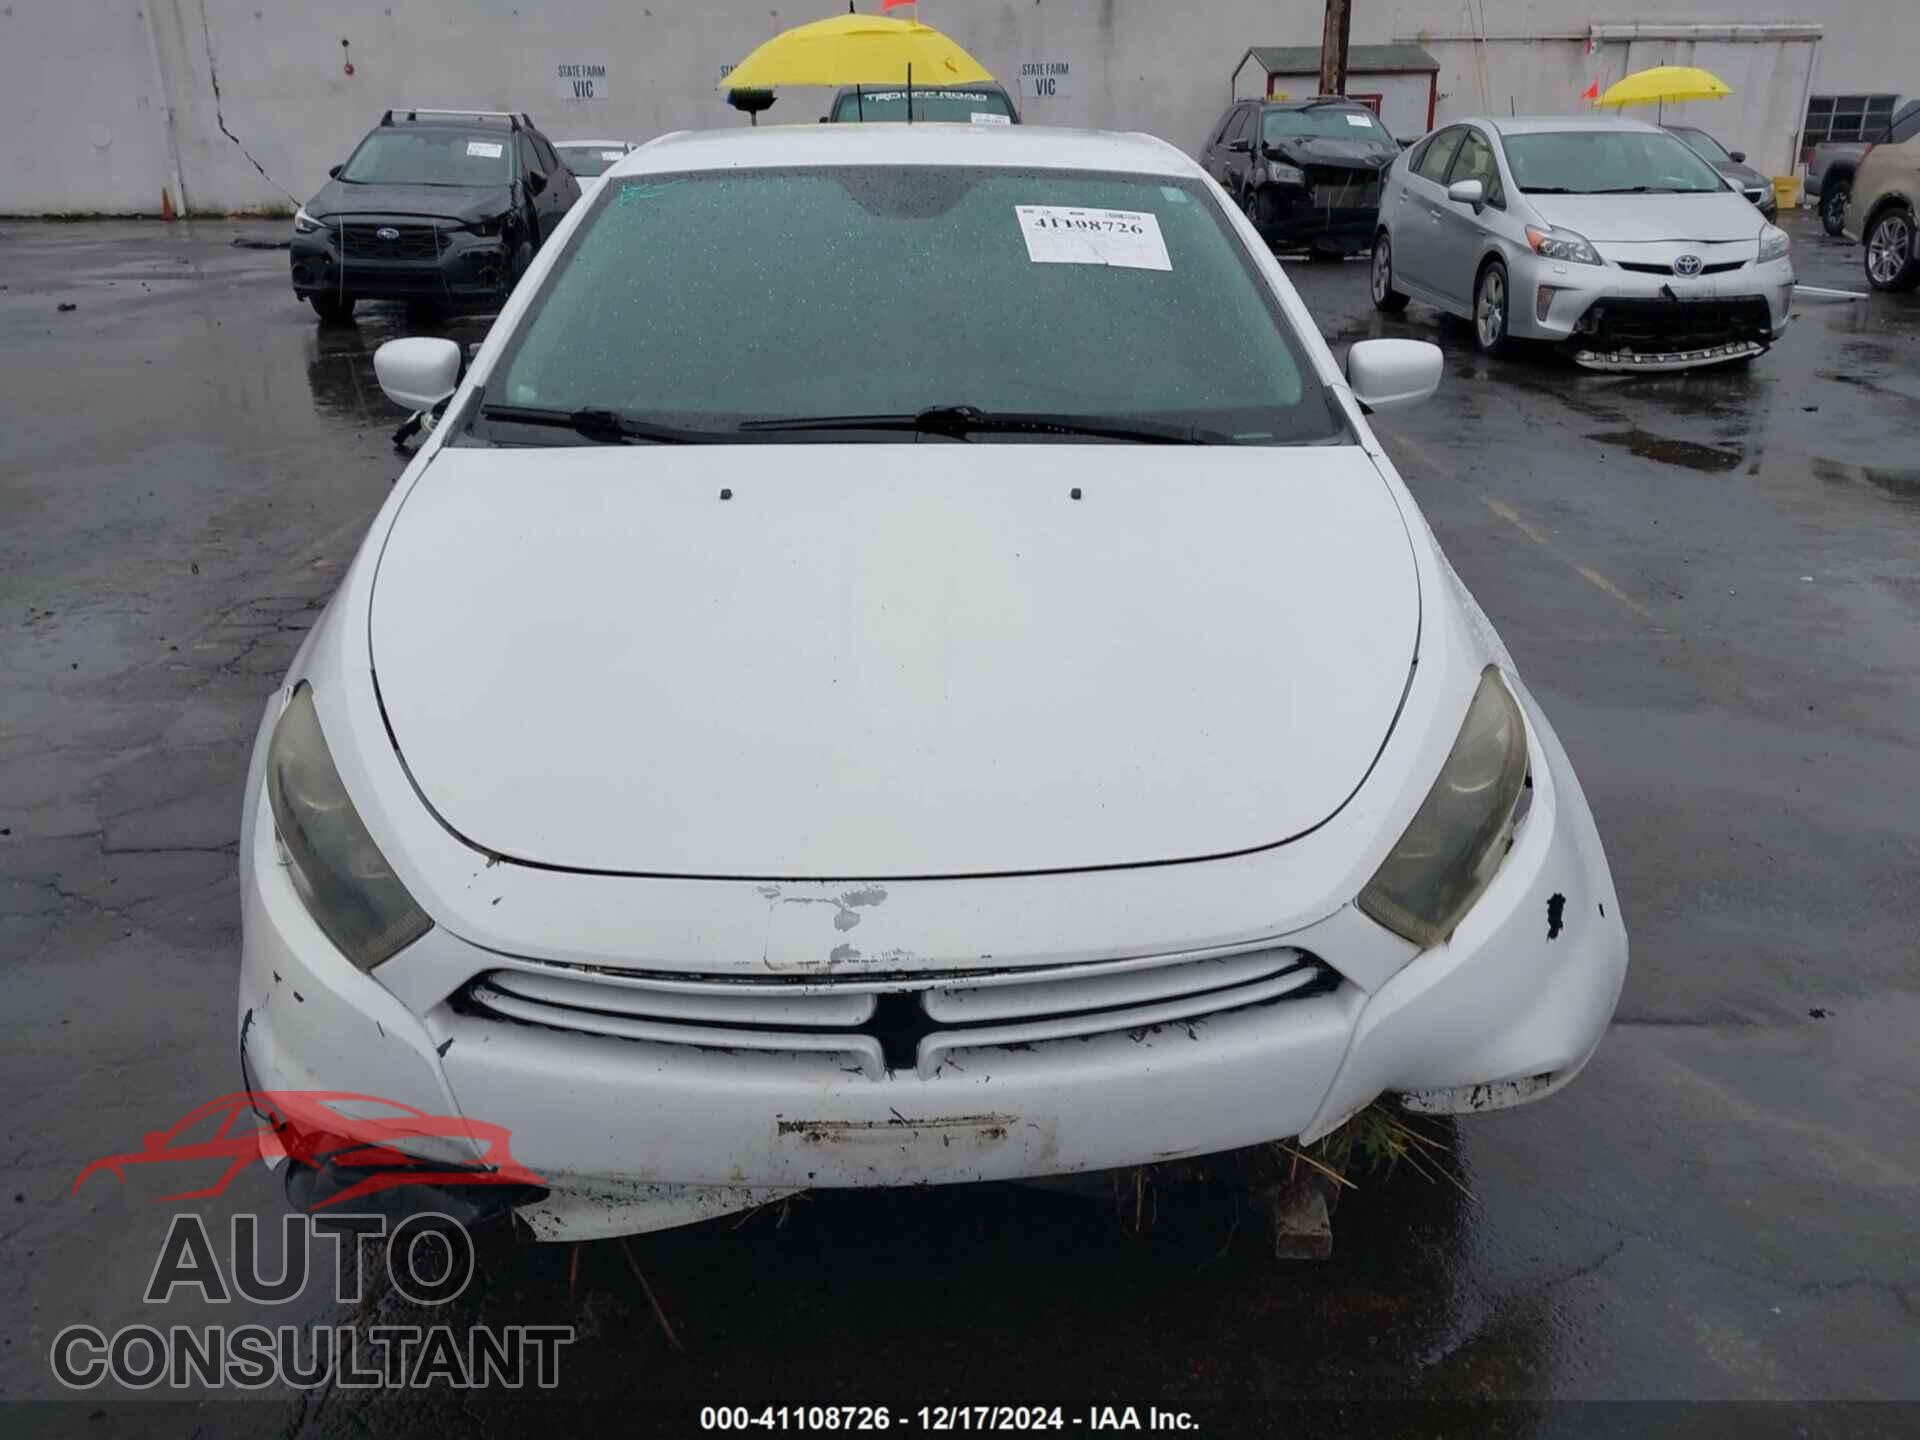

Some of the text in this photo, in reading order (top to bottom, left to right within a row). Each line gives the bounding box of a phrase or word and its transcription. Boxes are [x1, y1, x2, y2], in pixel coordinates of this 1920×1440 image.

[558, 64, 606, 78] STATE FARM
[1022, 62, 1069, 76] STATE FARM
[572, 79, 594, 98] VIC
[1035, 78, 1056, 96] VIC
[1034, 216, 1144, 235] 41108726
